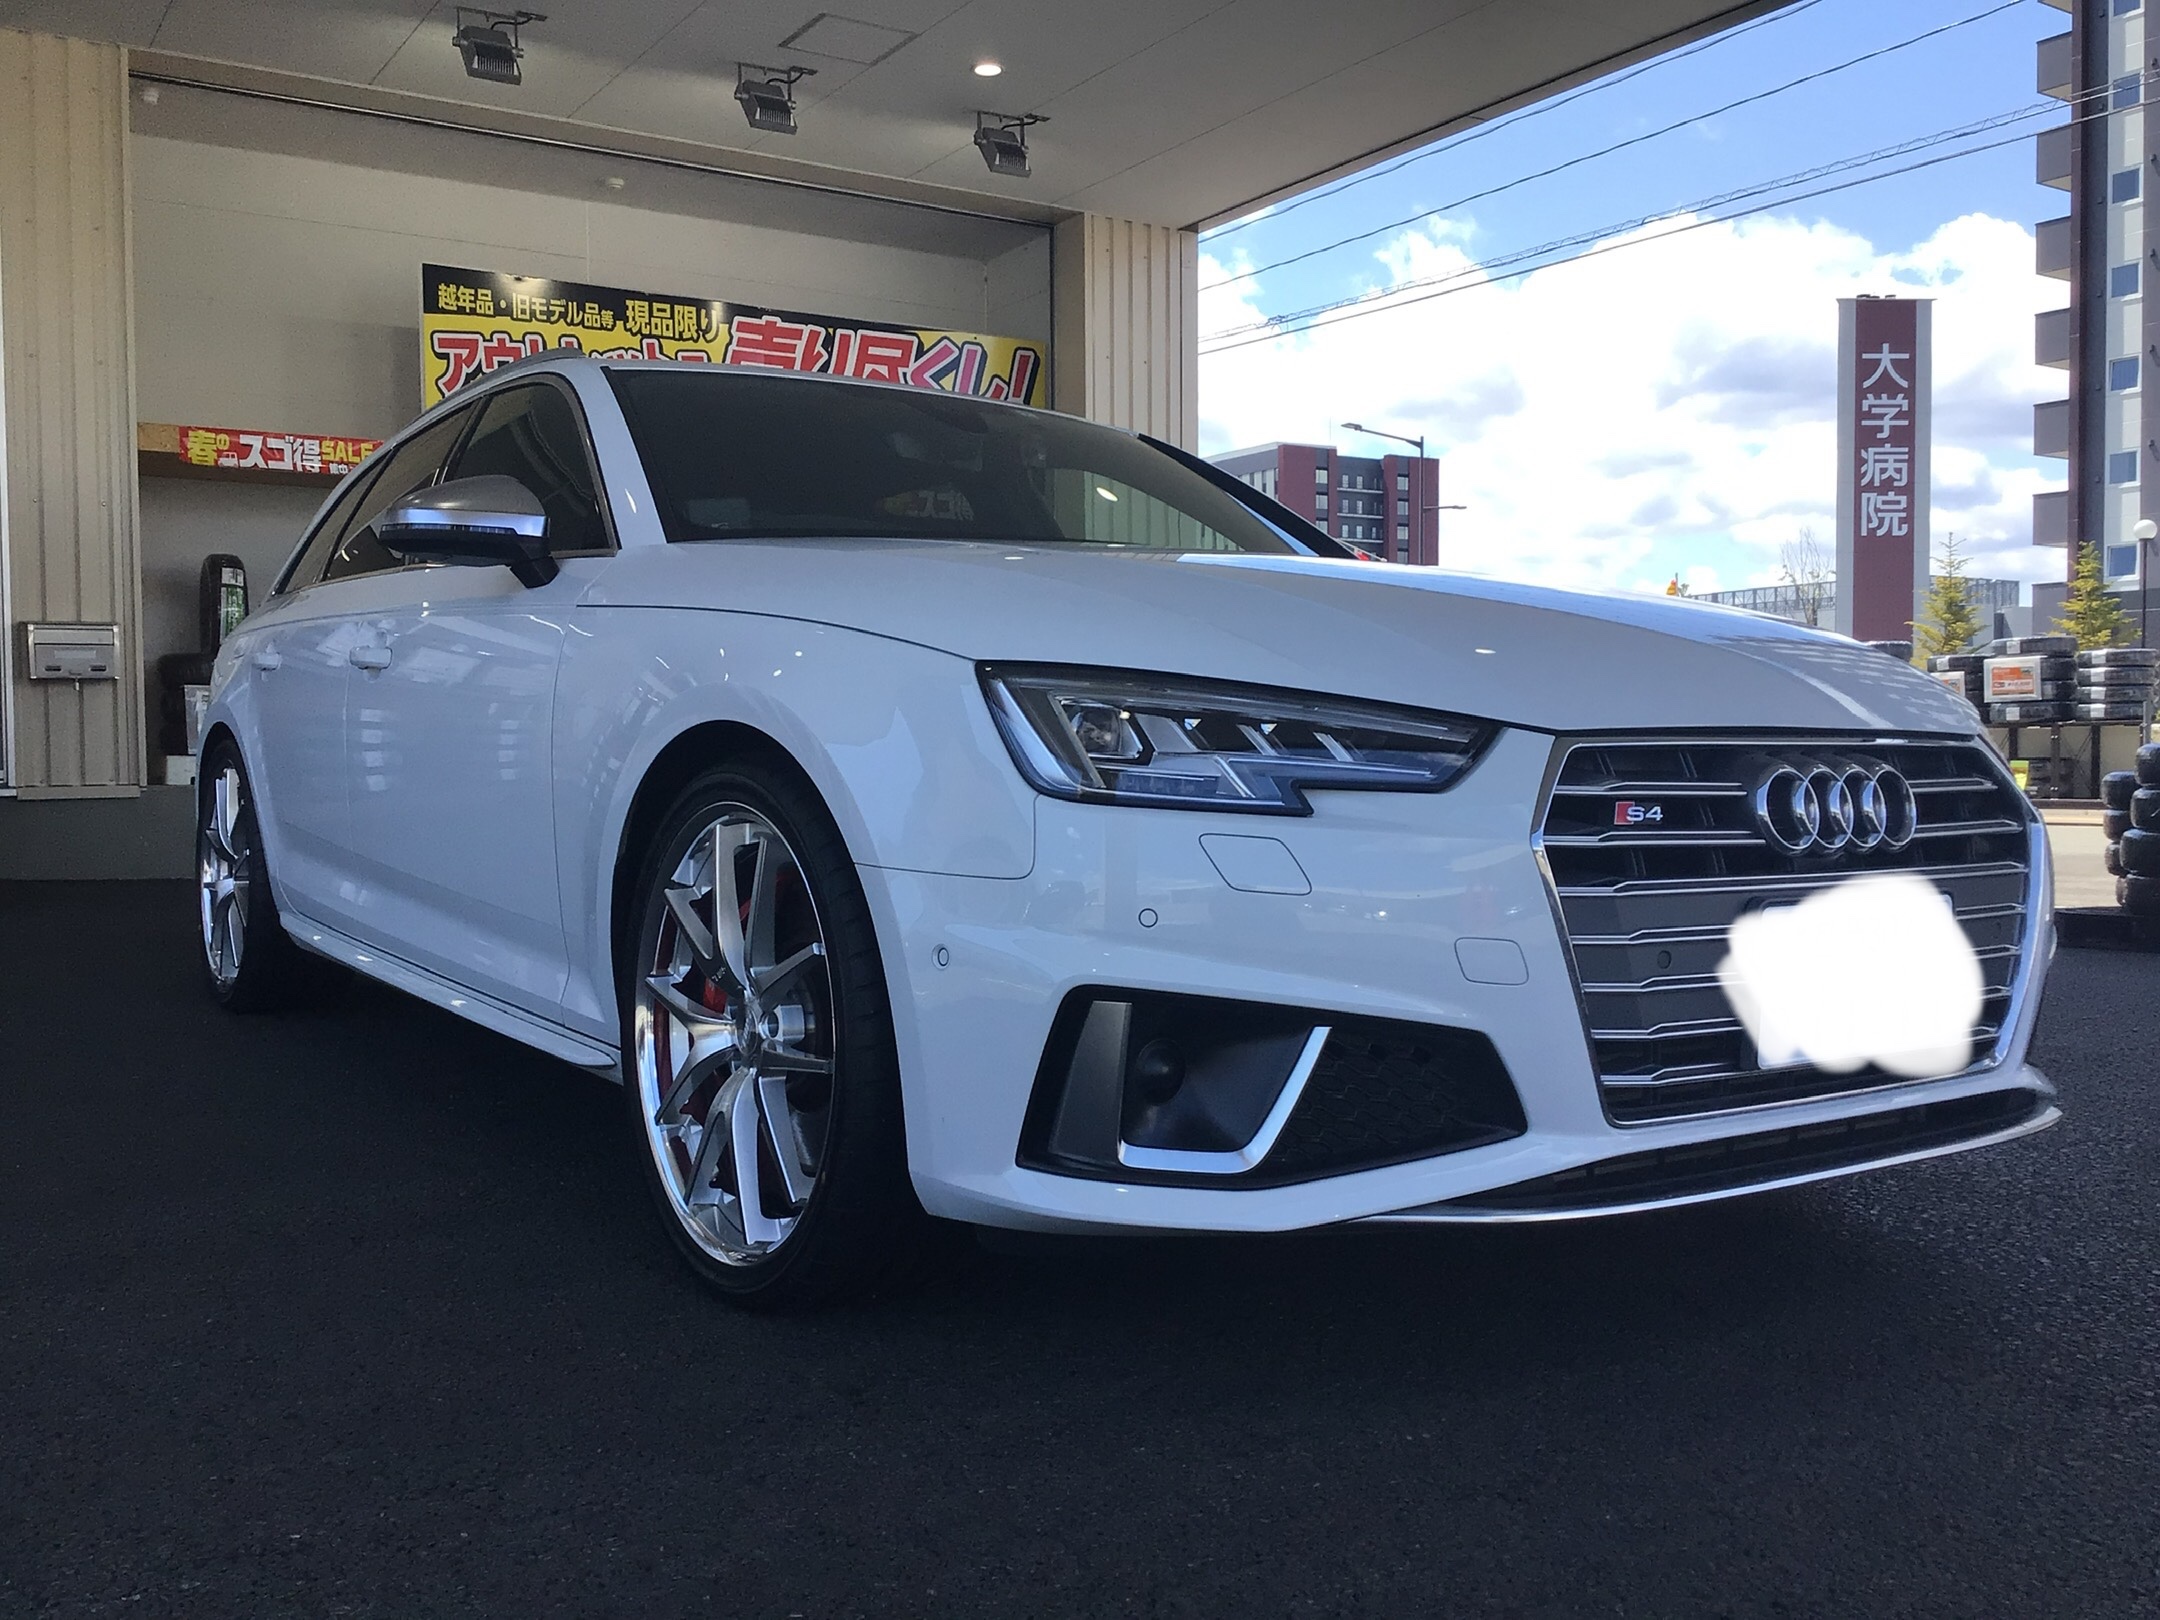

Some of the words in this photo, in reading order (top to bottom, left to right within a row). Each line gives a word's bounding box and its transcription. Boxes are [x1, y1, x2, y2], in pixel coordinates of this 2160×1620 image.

[625, 299, 718, 342] 現品限り
[1861, 343, 1910, 537] 大学病院
[1625, 805, 1664, 822] S4
